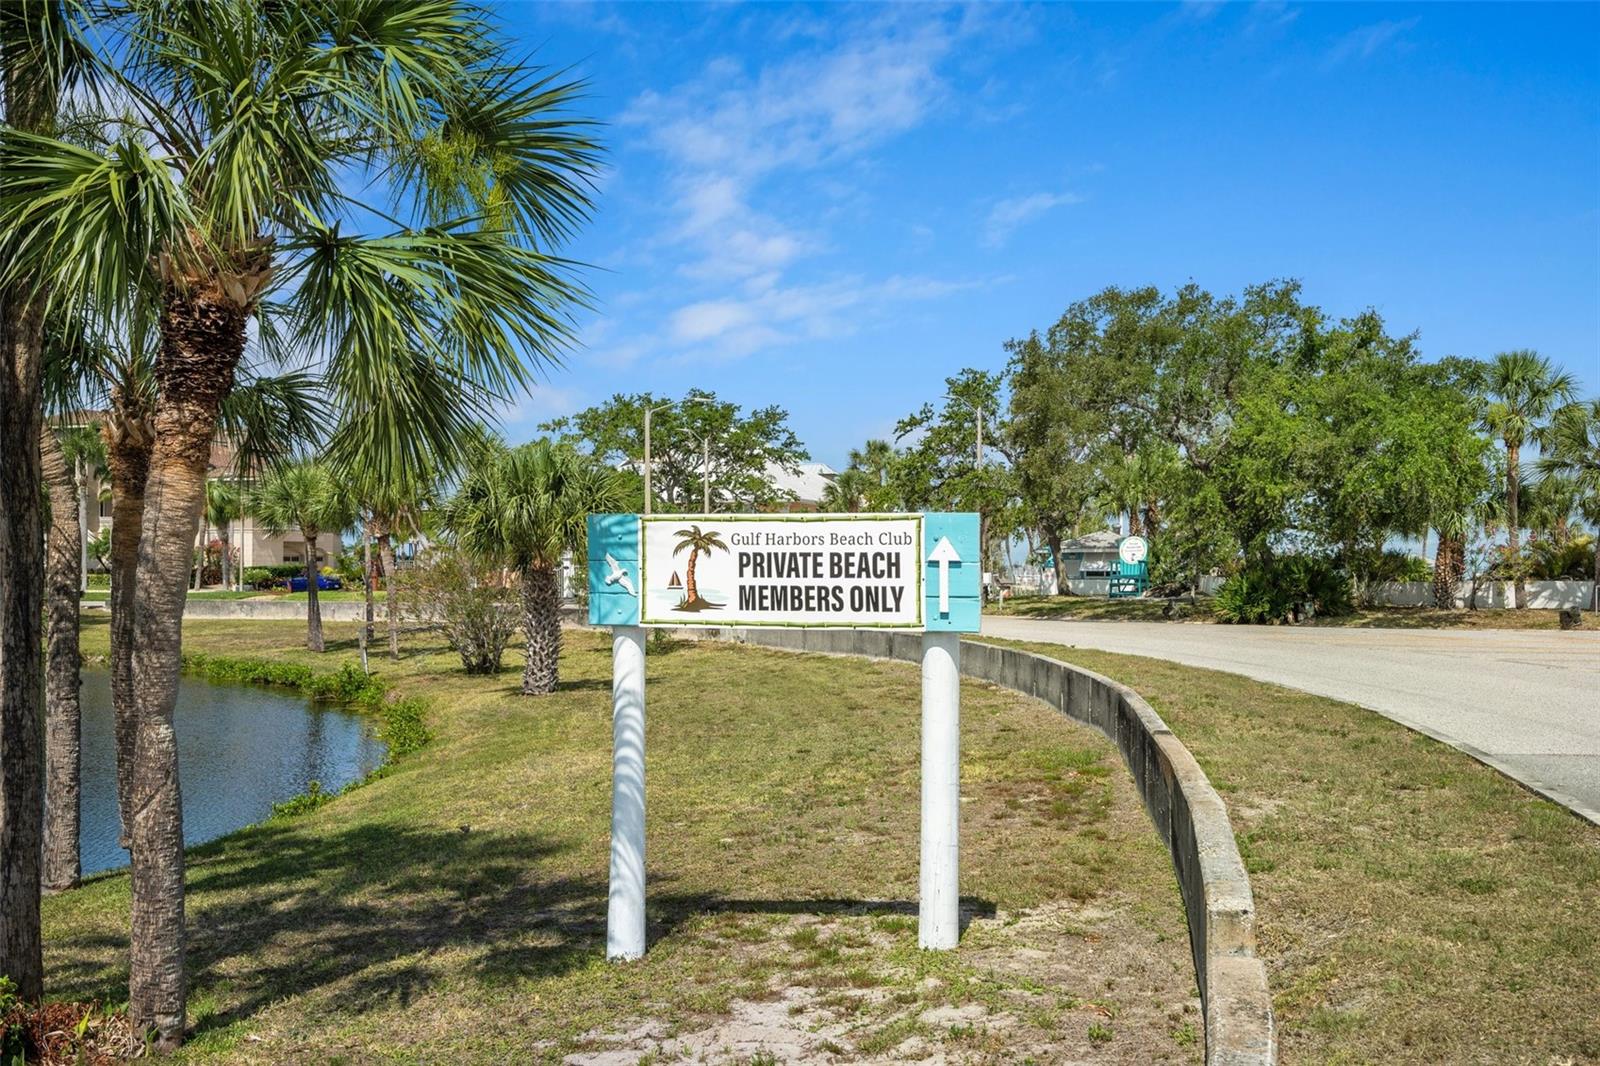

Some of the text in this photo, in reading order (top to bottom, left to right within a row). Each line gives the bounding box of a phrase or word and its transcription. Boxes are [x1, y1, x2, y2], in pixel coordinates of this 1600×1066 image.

[730, 531, 912, 546] Gulf Harbors Beach Club
[738, 552, 901, 579] PRIVATE BEACH
[738, 585, 904, 612] MEMBERS ONLY
